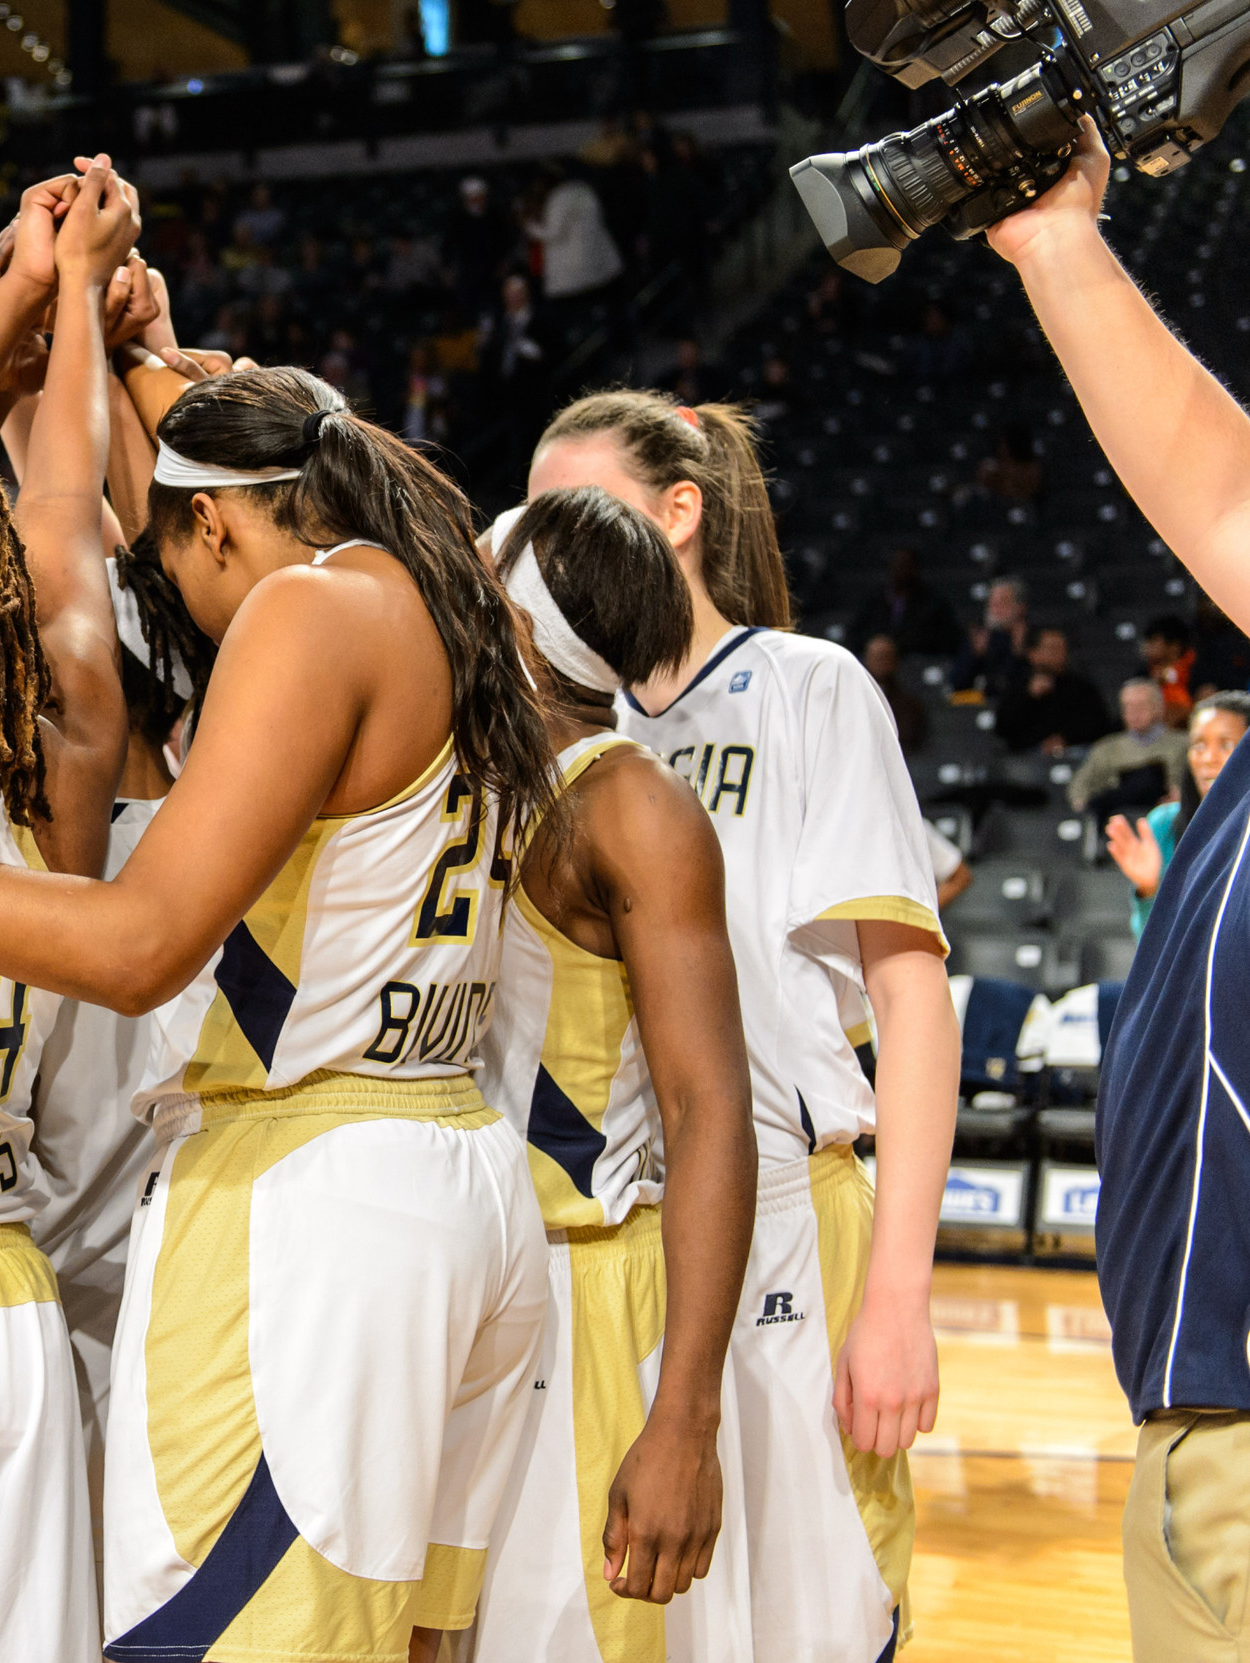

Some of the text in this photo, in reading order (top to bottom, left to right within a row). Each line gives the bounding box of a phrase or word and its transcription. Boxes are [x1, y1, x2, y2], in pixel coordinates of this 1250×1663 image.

[1011, 90, 1043, 113] FUJINON
[762, 1291, 794, 1317] R
[755, 1311, 806, 1327] RUSSELL
